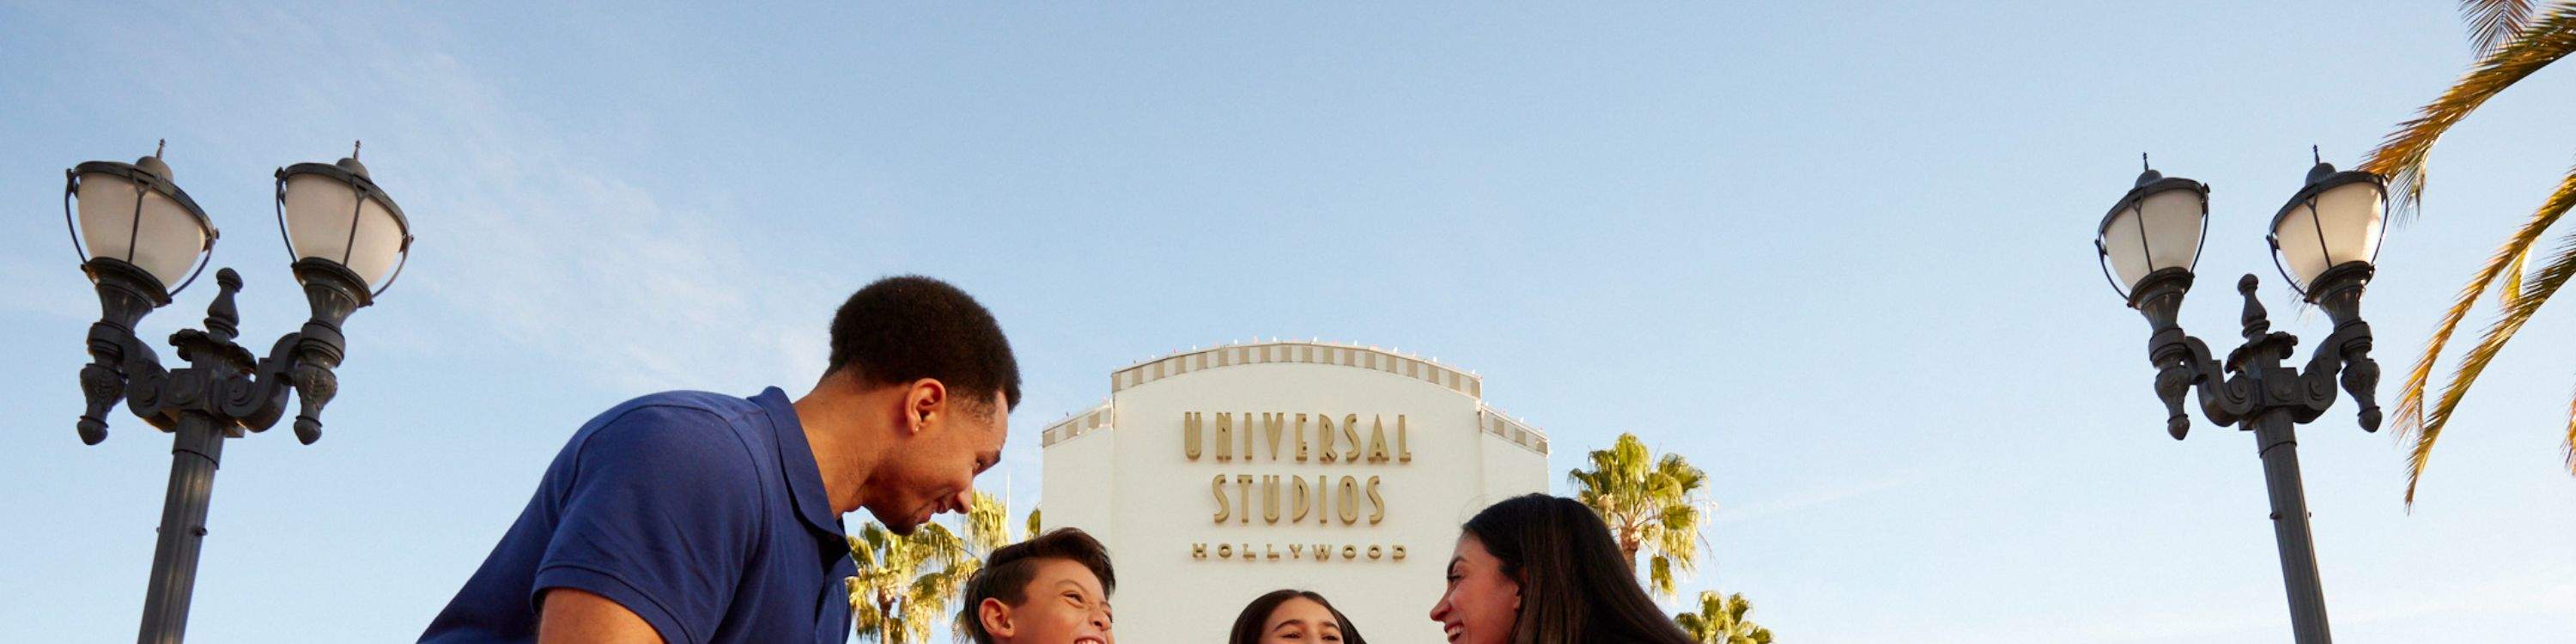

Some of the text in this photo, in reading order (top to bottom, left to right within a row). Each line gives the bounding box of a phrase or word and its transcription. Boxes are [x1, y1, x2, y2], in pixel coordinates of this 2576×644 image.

[1183, 411, 1412, 462] UNIVERSAL
[1212, 474, 1386, 525] STUDIOS
[1192, 543, 1406, 559] HOLLYWOOD
